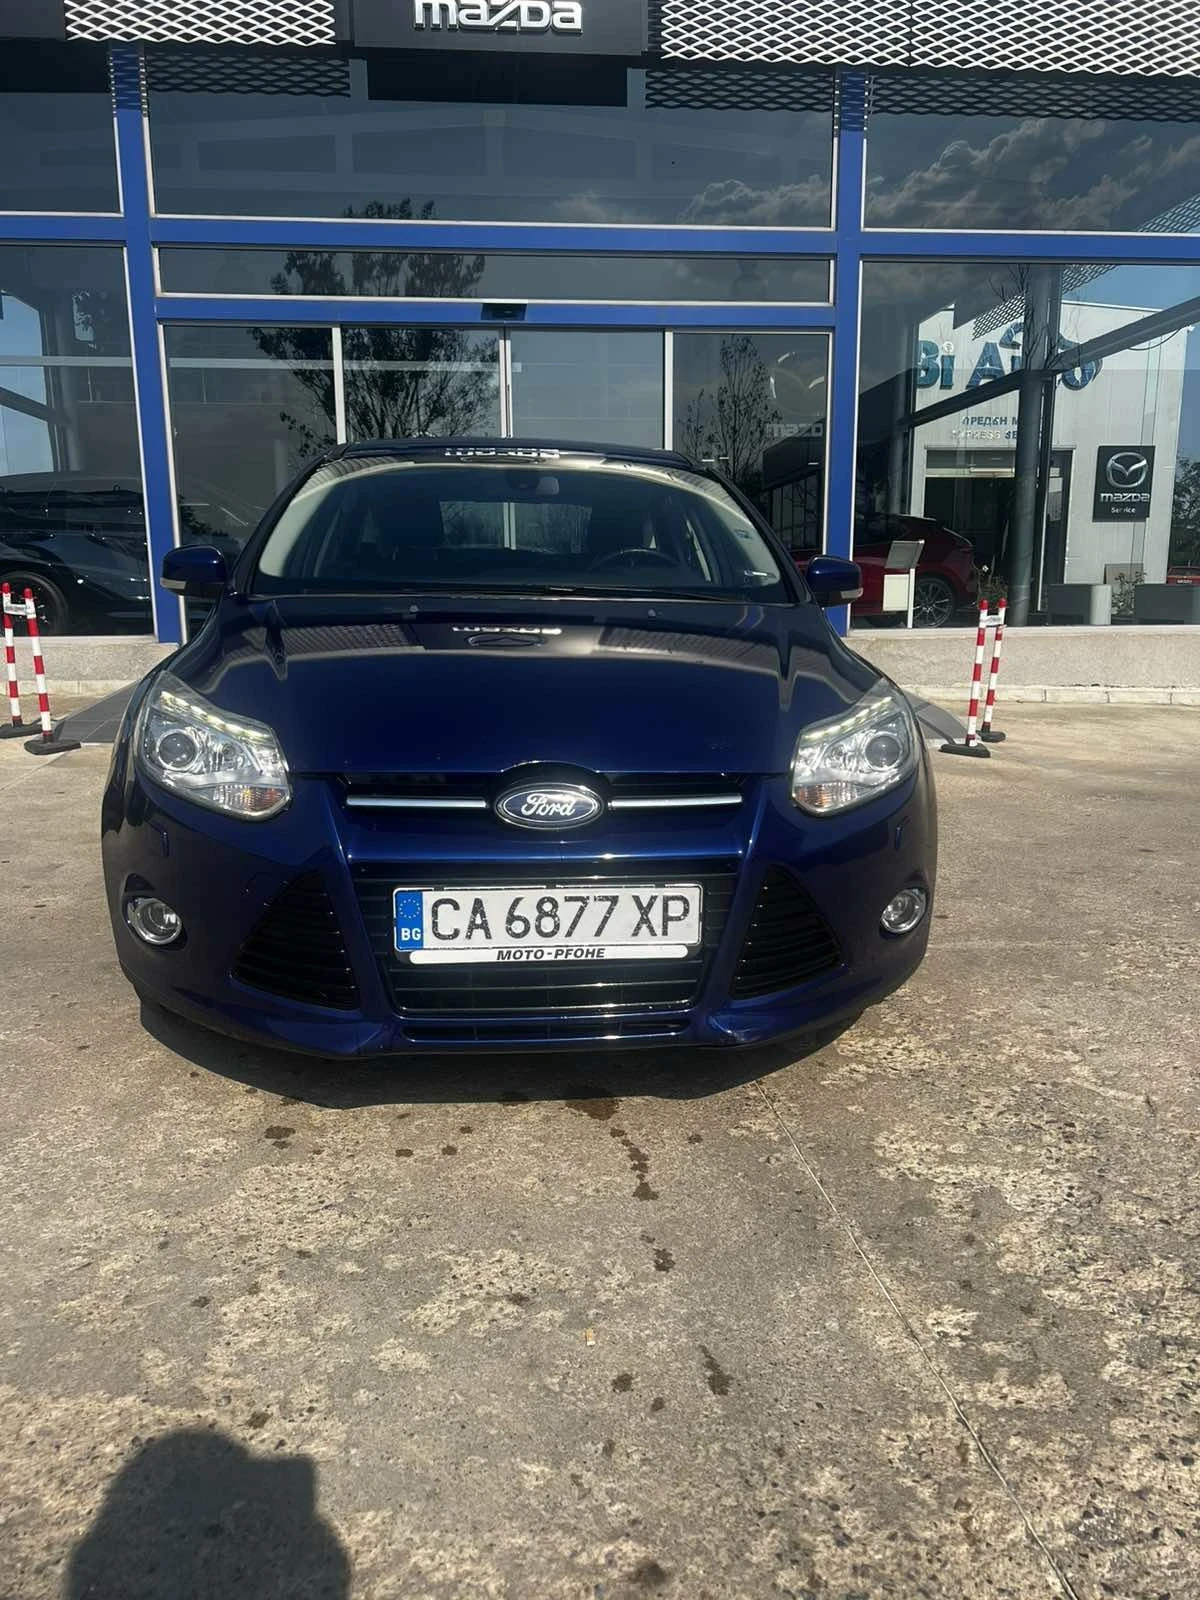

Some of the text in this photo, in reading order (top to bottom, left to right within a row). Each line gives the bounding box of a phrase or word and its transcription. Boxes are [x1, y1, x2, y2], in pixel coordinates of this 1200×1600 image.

[413, 0, 584, 33] mazda
[520, 793, 576, 816] Ford
[430, 894, 691, 941] CA 6877 XP
[400, 927, 422, 942] BG
